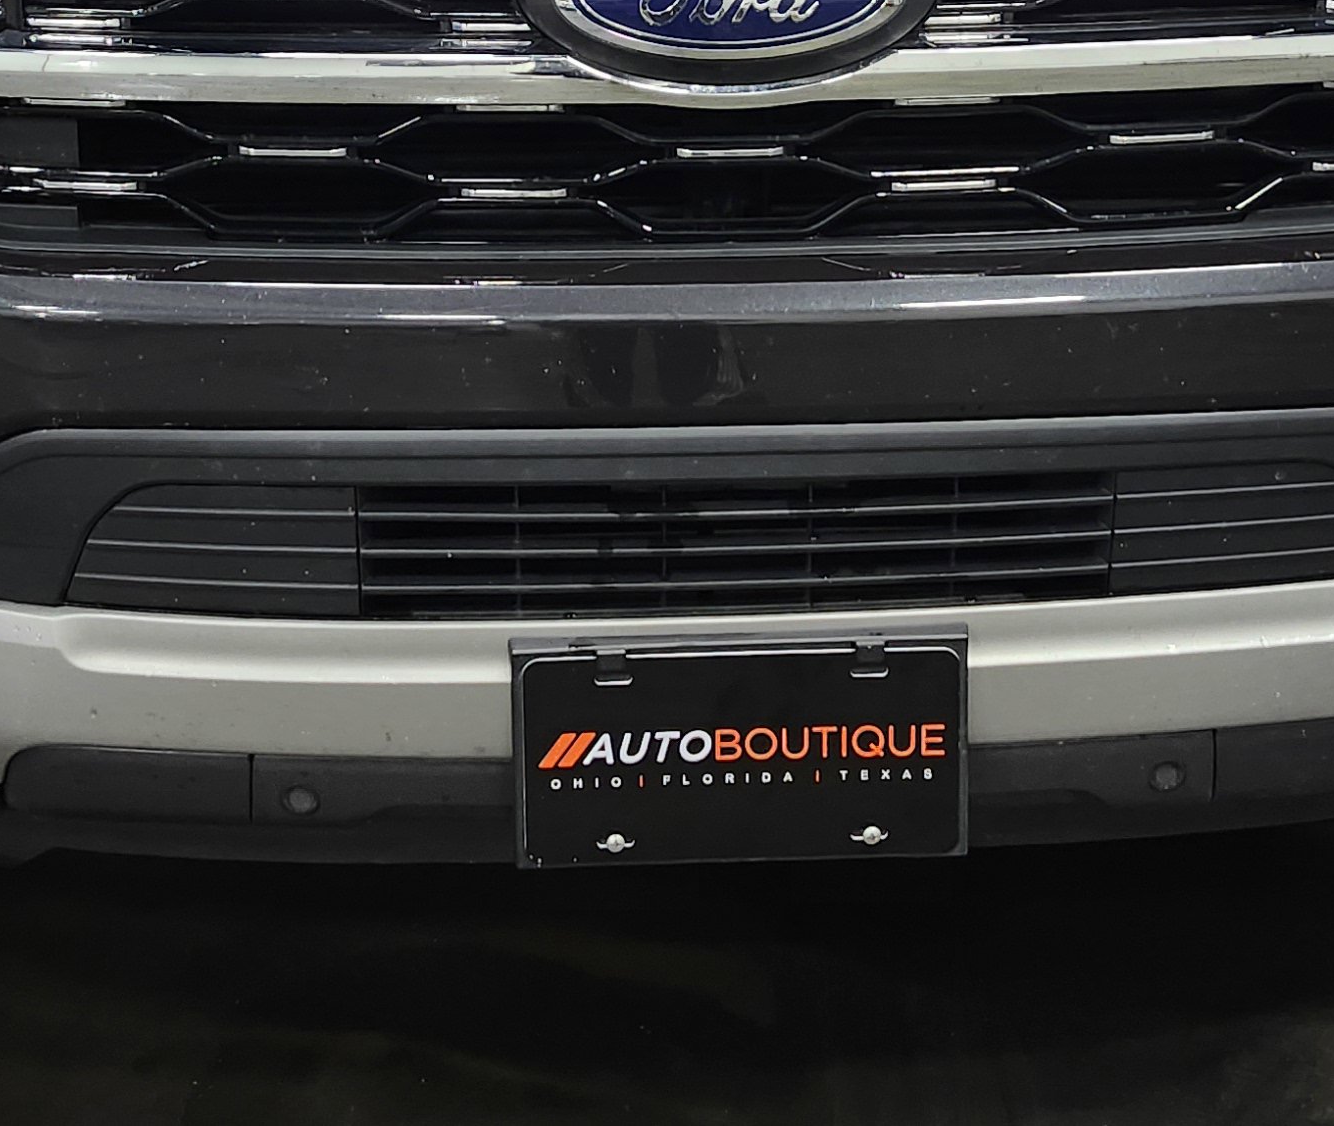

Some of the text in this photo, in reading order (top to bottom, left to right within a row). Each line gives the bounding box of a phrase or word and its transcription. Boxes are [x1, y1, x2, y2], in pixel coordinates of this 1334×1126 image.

[582, 723, 946, 766] AUTOBOUTIQUE
[550, 768, 933, 790] OHIO FLORIDA TEXAS
